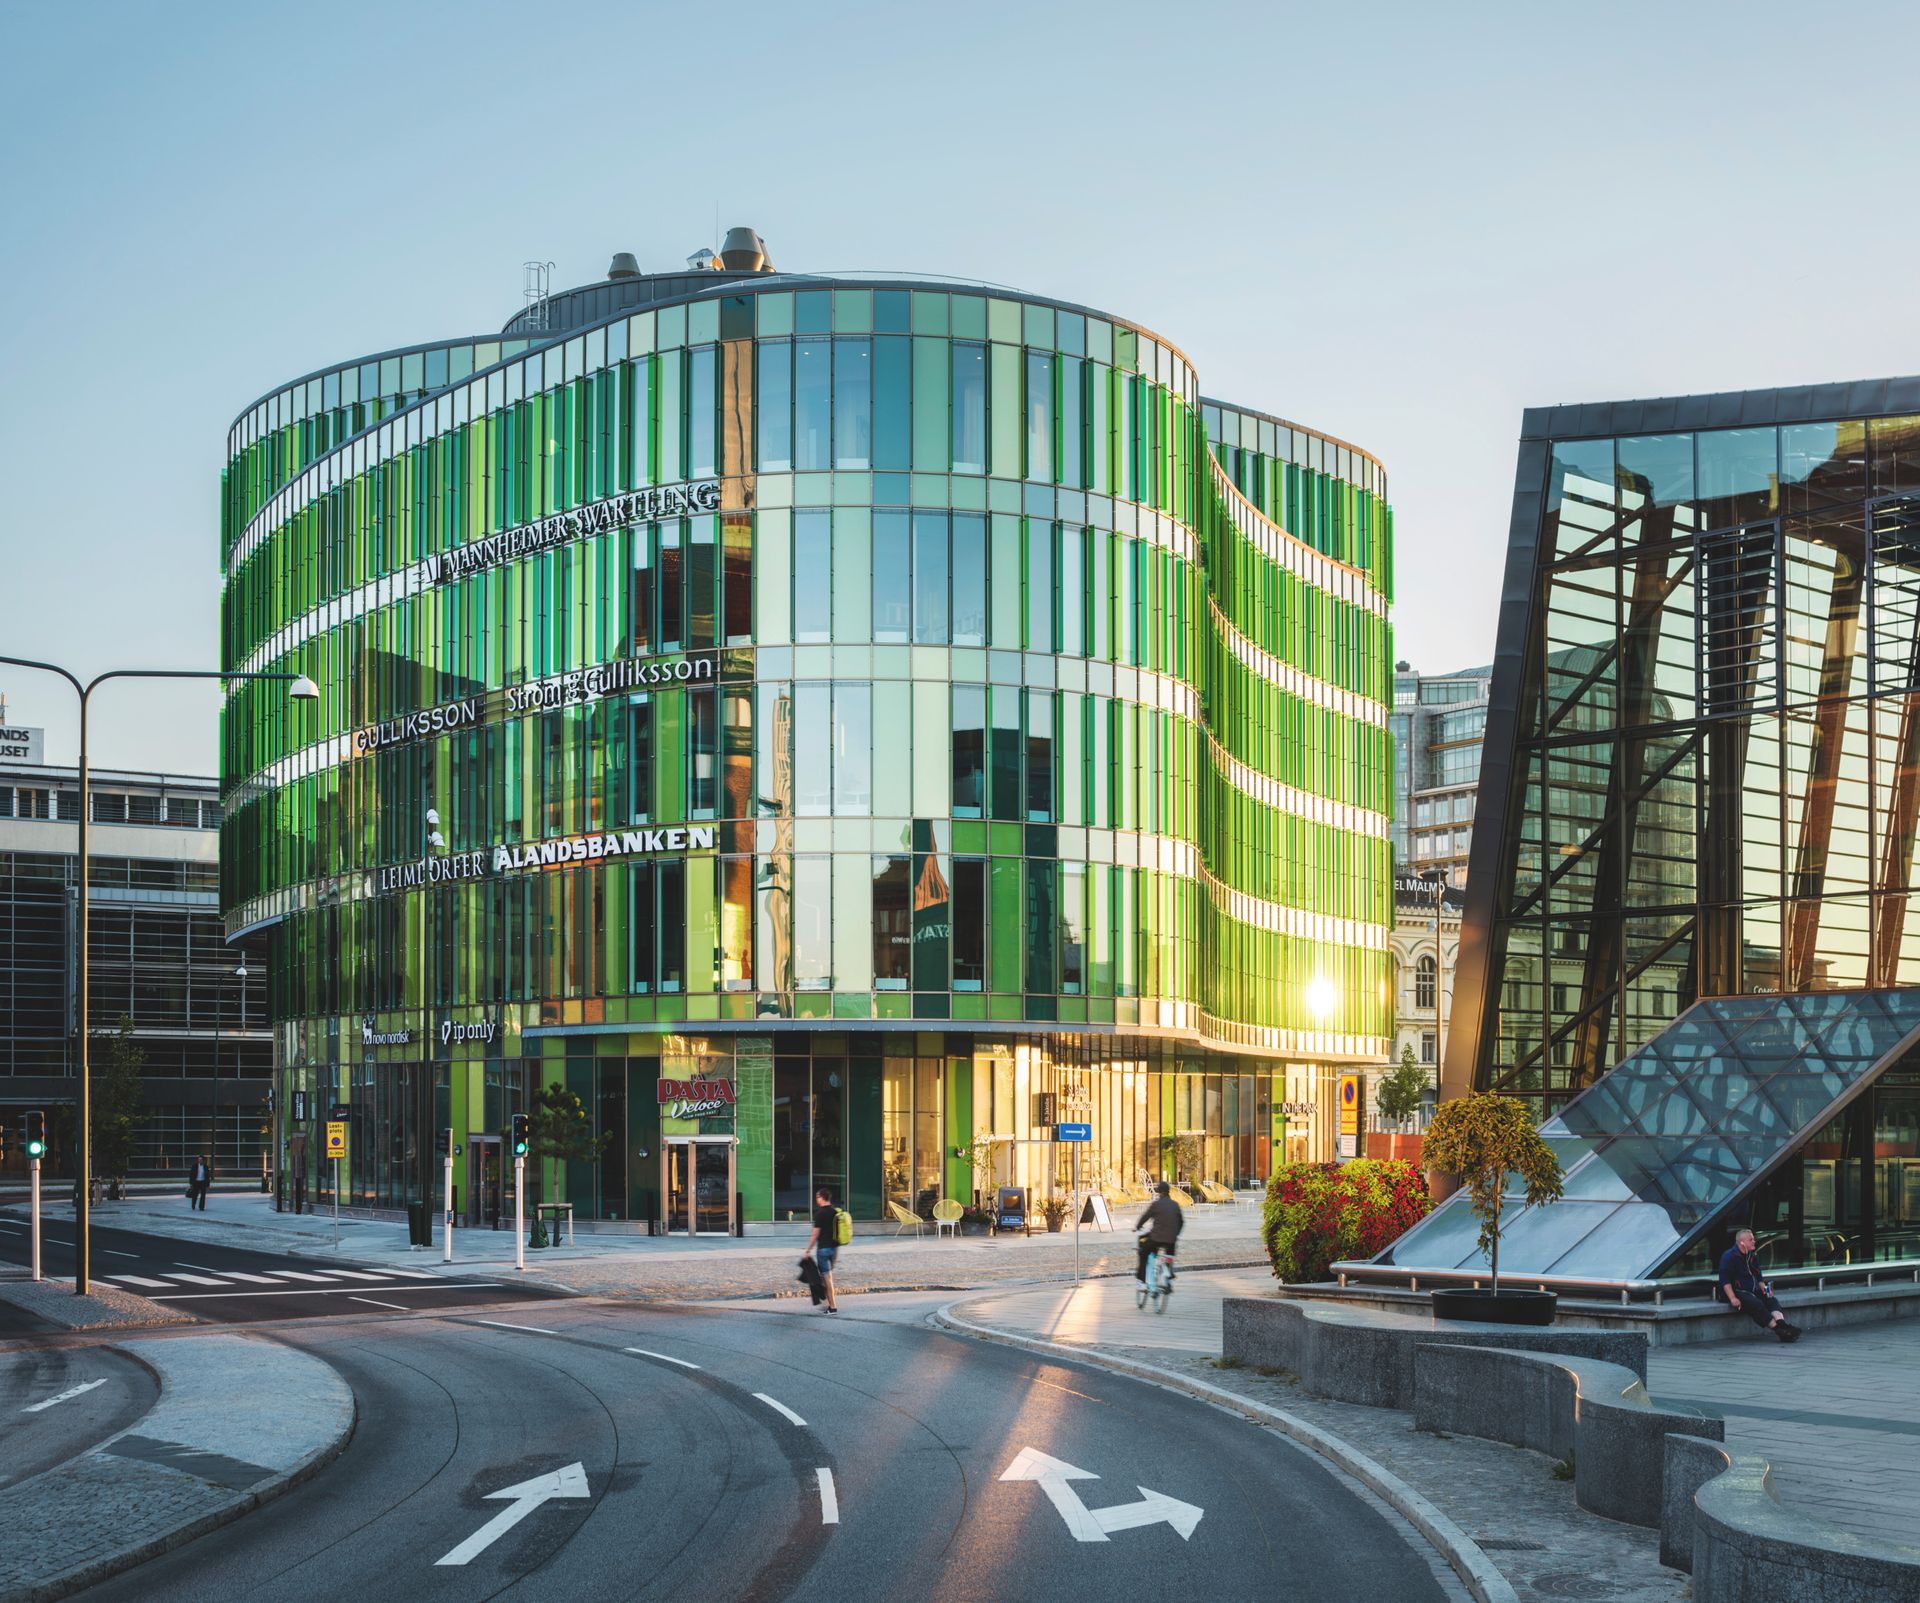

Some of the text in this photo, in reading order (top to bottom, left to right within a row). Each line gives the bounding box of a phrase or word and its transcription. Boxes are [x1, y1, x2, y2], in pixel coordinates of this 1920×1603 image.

[447, 482, 718, 576] MANNHEIMER SWARTLING
[583, 657, 713, 694] Gulliksson
[356, 699, 475, 752] GULLIKSSON
[497, 826, 716, 871] ÅLANDSBANKEN
[381, 851, 484, 890] LEIMDÖRFER
[372, 1029, 411, 1045] novo nordisk
[453, 1018, 496, 1044] ip only
[657, 1078, 736, 1104] PASTA
[671, 1099, 724, 1119] Veloce
